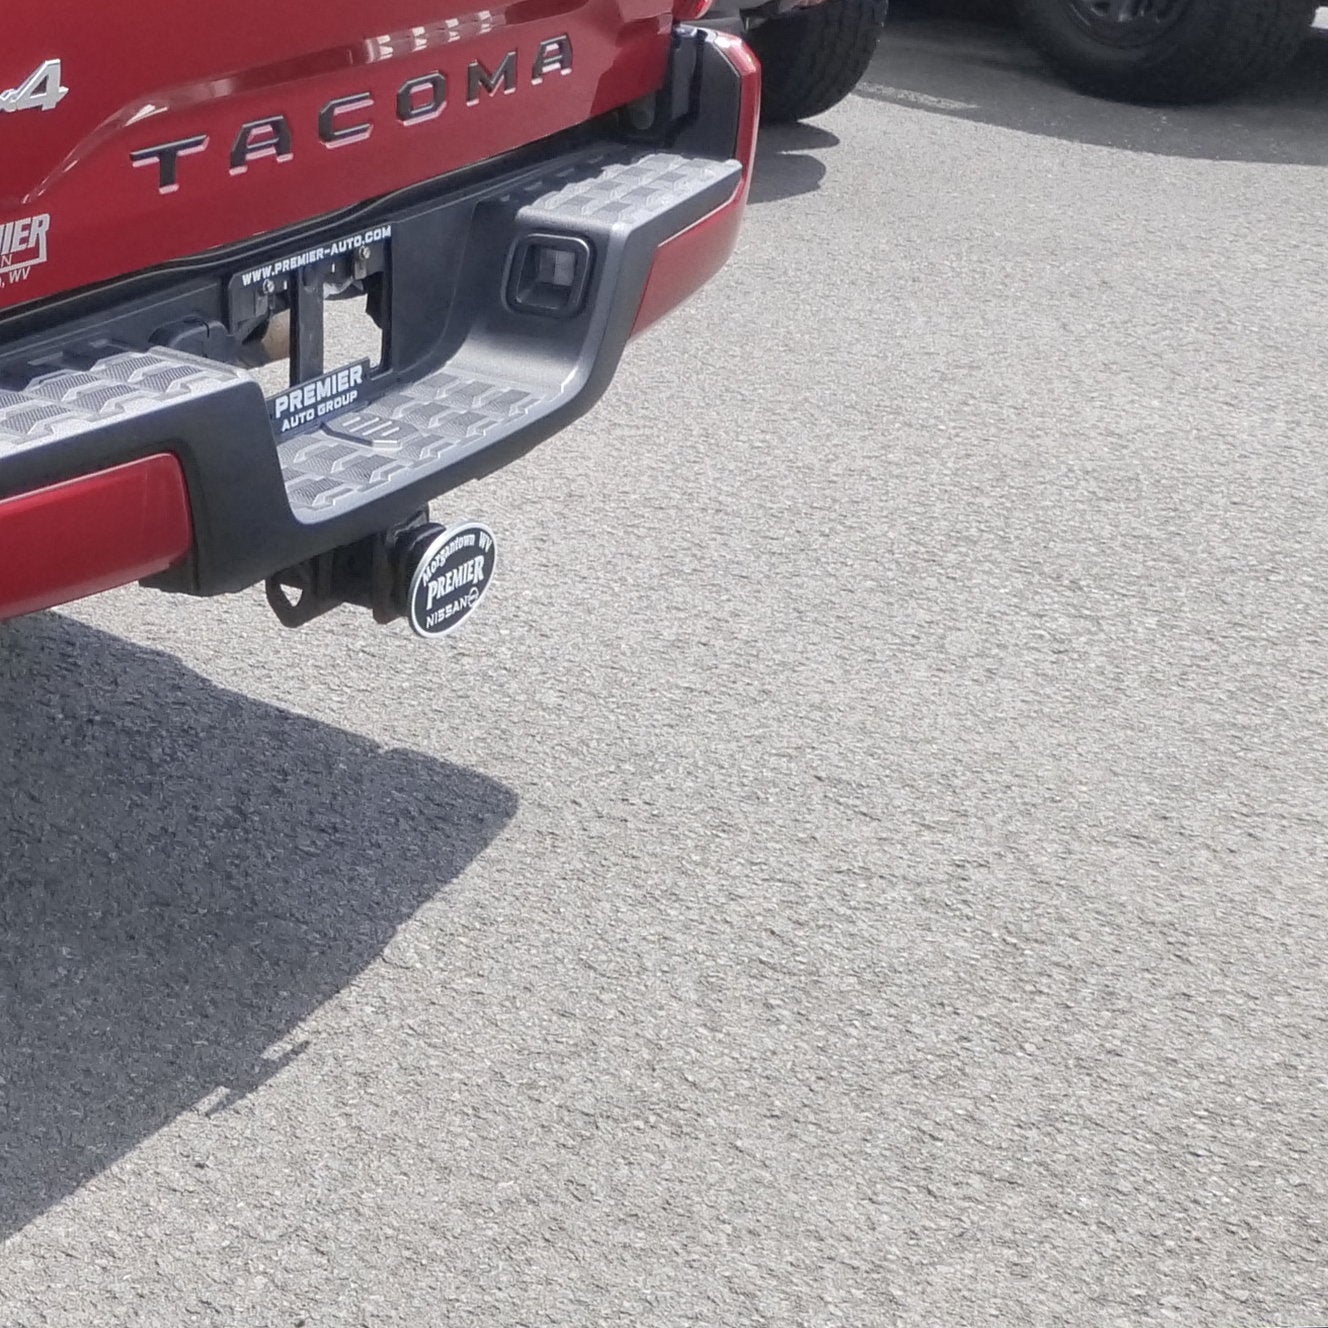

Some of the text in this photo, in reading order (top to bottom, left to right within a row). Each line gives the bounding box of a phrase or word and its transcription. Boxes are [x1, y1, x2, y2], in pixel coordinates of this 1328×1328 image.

[130, 33, 573, 193] TACOMA
[8, 266, 32, 285] WV
[242, 224, 392, 287] WWW.PREMIER-AUTO.COM
[275, 364, 363, 419] PREMIER
[282, 389, 358, 432] AUTO GROUP
[422, 530, 493, 587] Morgantown WV
[426, 555, 485, 611] PREMIER
[426, 595, 470, 629] NISSAN
